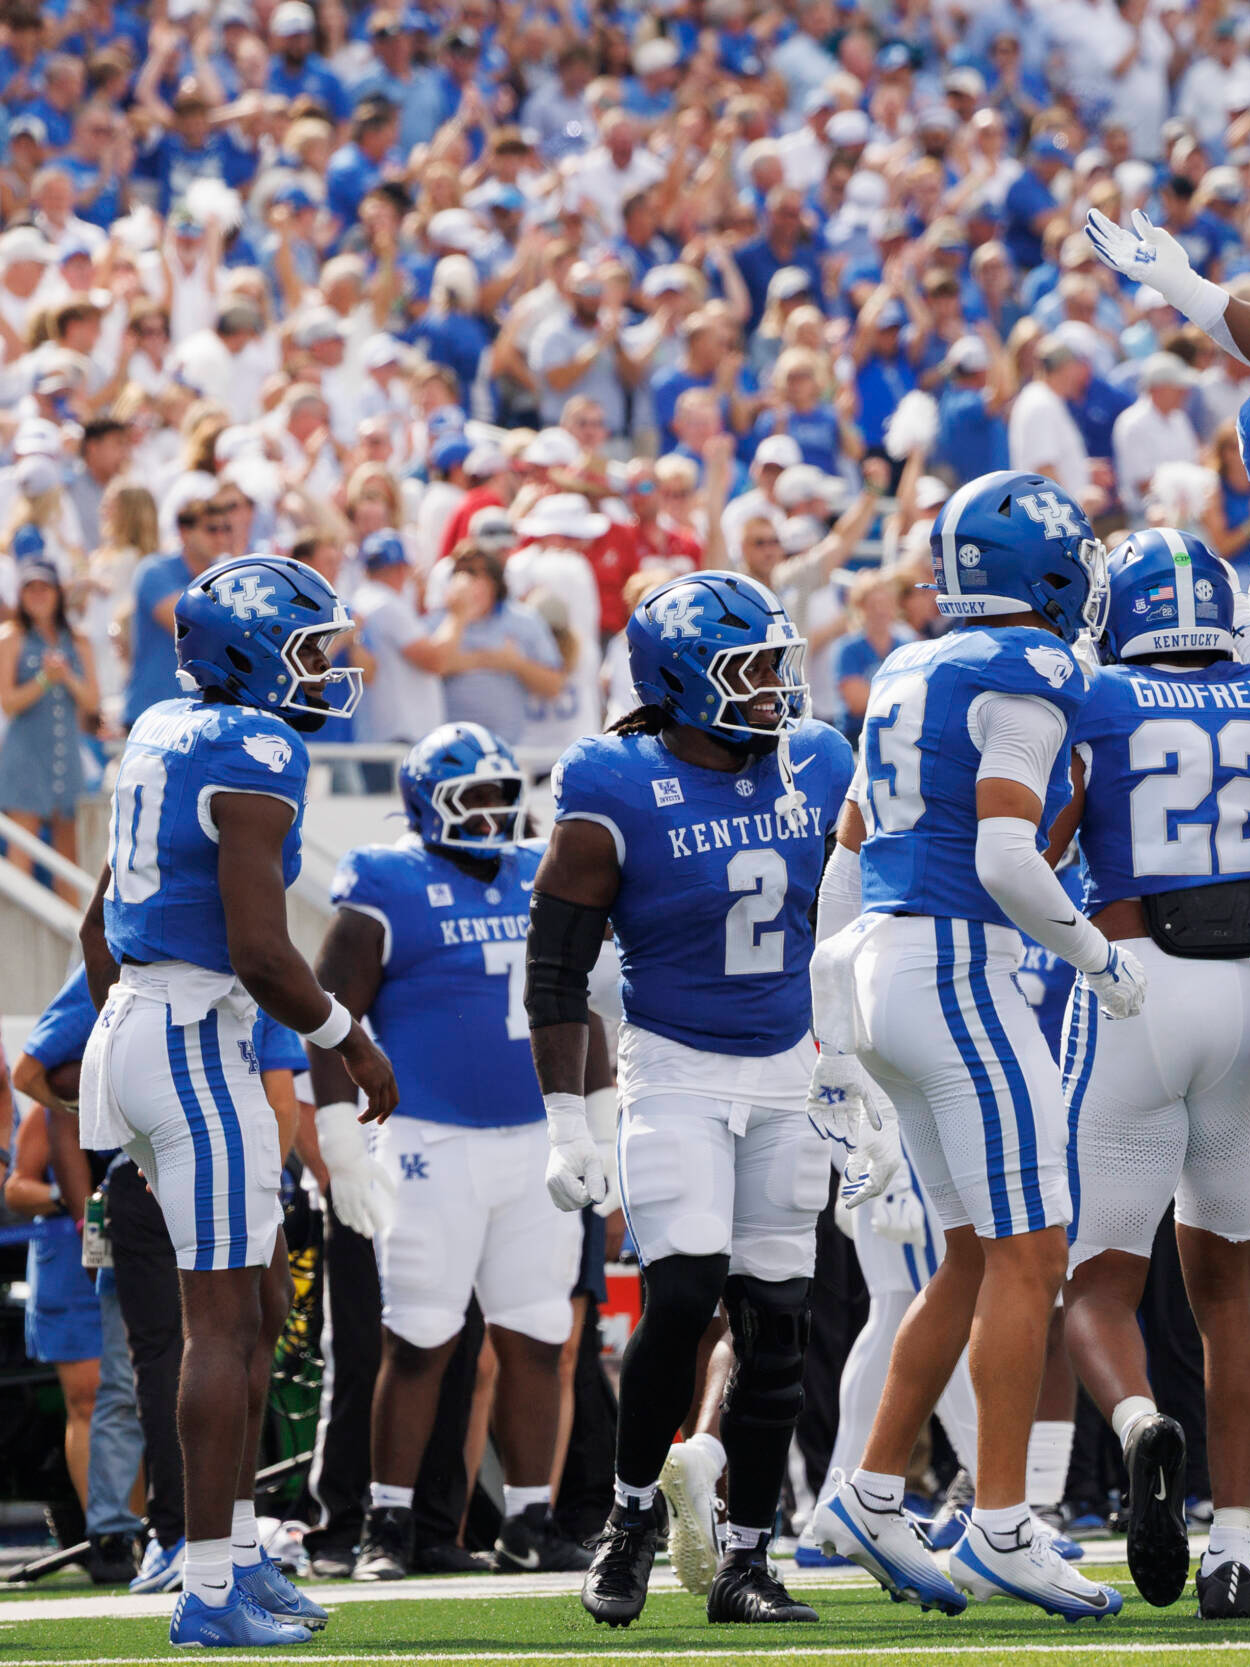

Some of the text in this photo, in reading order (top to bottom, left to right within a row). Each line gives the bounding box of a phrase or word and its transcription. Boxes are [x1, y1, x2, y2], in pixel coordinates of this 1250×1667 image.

[1017, 492, 1082, 540] UK
[960, 546, 980, 566] SEC
[215, 576, 278, 620] UK
[1162, 607, 1173, 616] 22
[1195, 580, 1213, 601] SEC
[655, 595, 704, 640] UK
[1153, 633, 1220, 649] KENTUCKY
[858, 672, 928, 836] 3
[735, 779, 755, 797] SEC
[103, 754, 168, 904] 0
[725, 848, 788, 976] 2
[482, 940, 531, 1041] 7
[400, 1153, 430, 1180] UK
